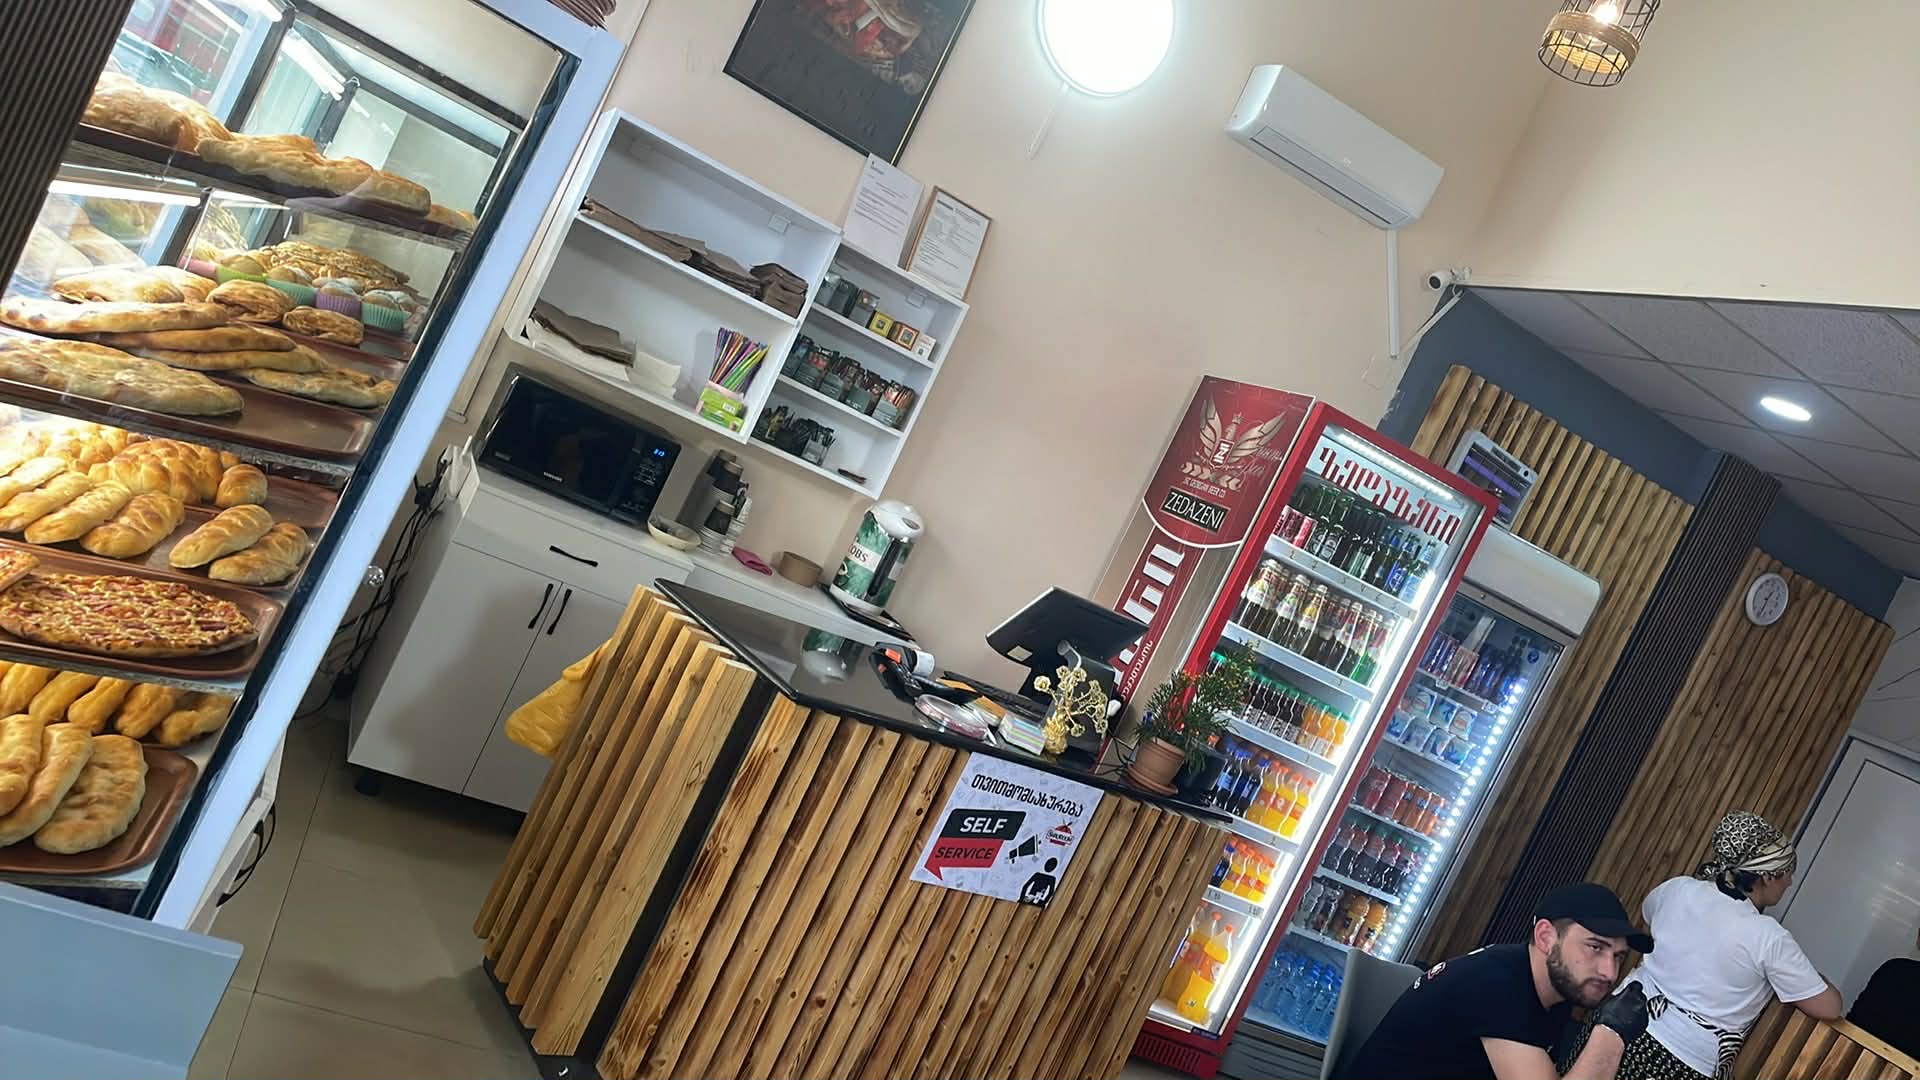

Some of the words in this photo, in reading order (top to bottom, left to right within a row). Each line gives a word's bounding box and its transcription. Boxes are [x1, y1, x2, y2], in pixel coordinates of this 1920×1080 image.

[1164, 491, 1225, 529] ZEDAZENI
[1319, 447, 1461, 544] ზედაზენი
[971, 773, 1084, 818] თვითმომსახურება
[960, 817, 1008, 834] SELF
[935, 846, 995, 860] SERVICE
